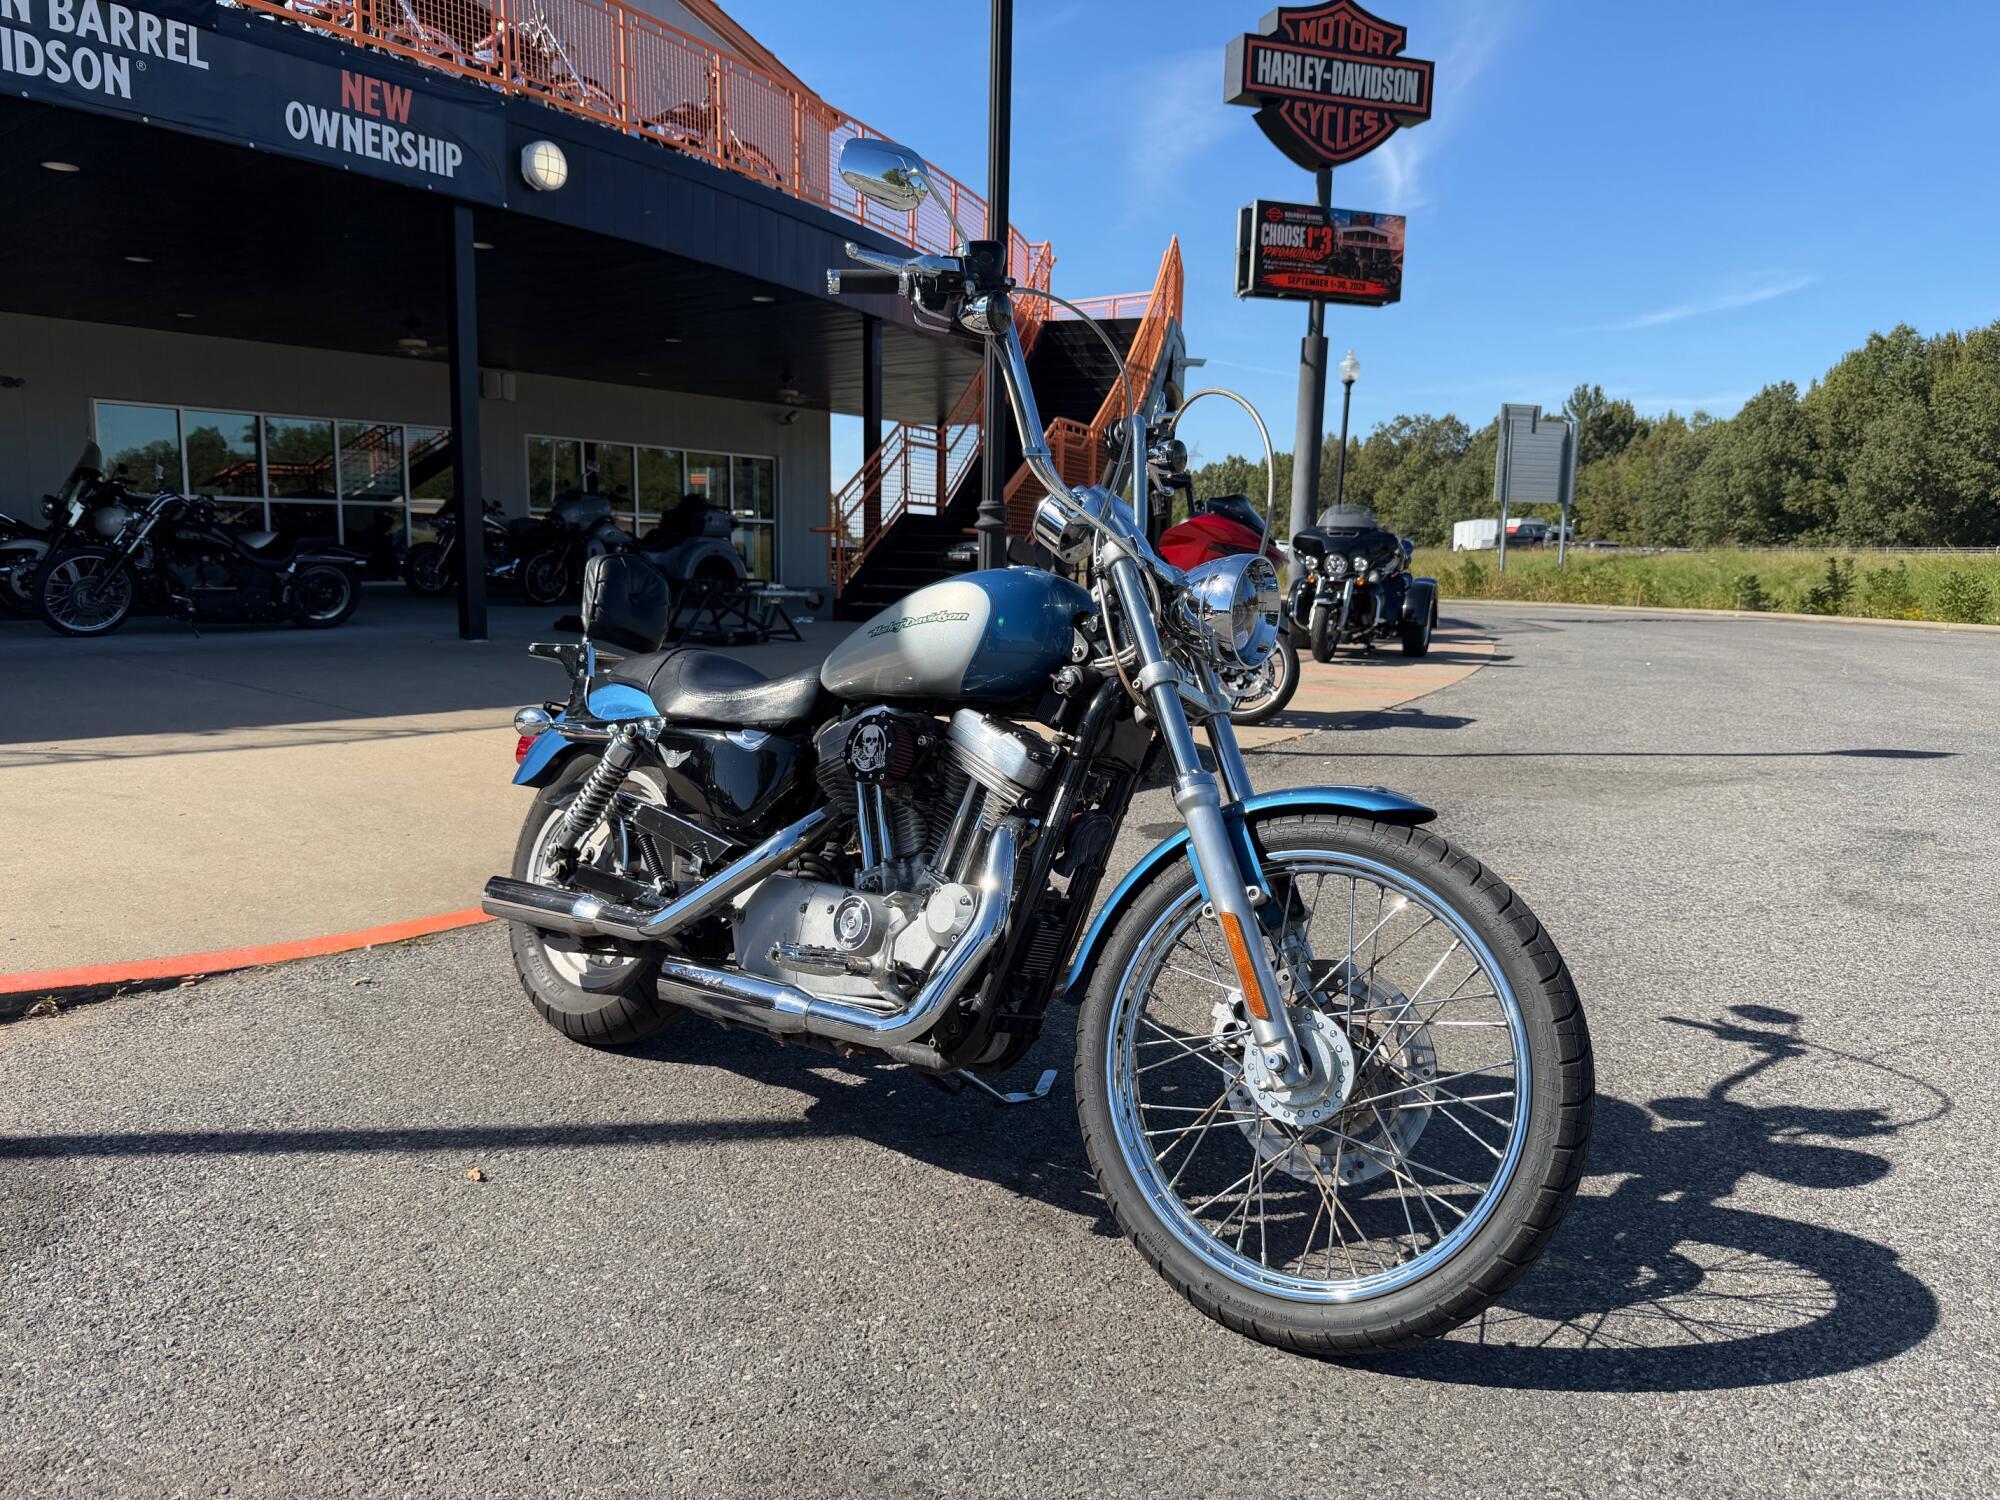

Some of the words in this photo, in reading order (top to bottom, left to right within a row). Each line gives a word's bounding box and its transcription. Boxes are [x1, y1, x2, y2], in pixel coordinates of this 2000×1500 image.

[49, 0, 208, 69] BARREL
[1300, 10, 1384, 55] MOTOR
[341, 70, 413, 124] NEW
[1257, 48, 1419, 104] HARLEY-DAVIDSON
[285, 101, 462, 177] OWNERSHIP
[1294, 102, 1378, 150] CYCLES
[1261, 222, 1306, 248] CHOOSE
[1320, 226, 1333, 254] 3
[1262, 247, 1325, 260] PROMOTIONS
[1288, 275, 1328, 287] SEPTEMBER
